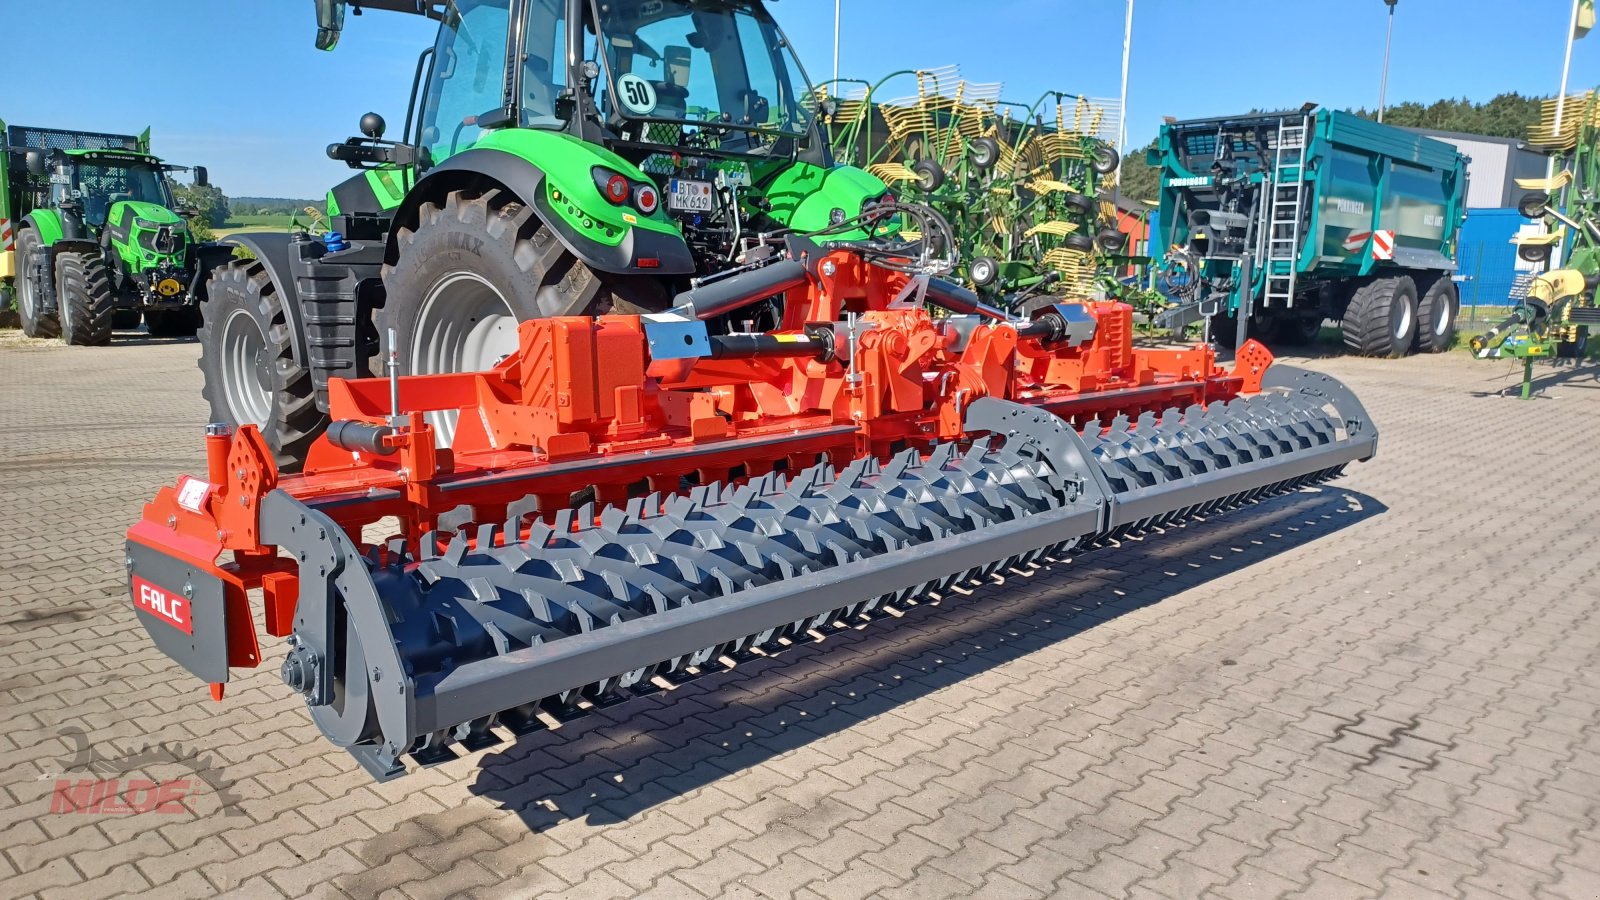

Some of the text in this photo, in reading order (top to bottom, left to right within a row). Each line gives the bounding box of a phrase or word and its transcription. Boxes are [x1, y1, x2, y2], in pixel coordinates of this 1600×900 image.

[624, 81, 650, 105] 50
[679, 182, 691, 195] BT
[140, 584, 184, 624] FALC
